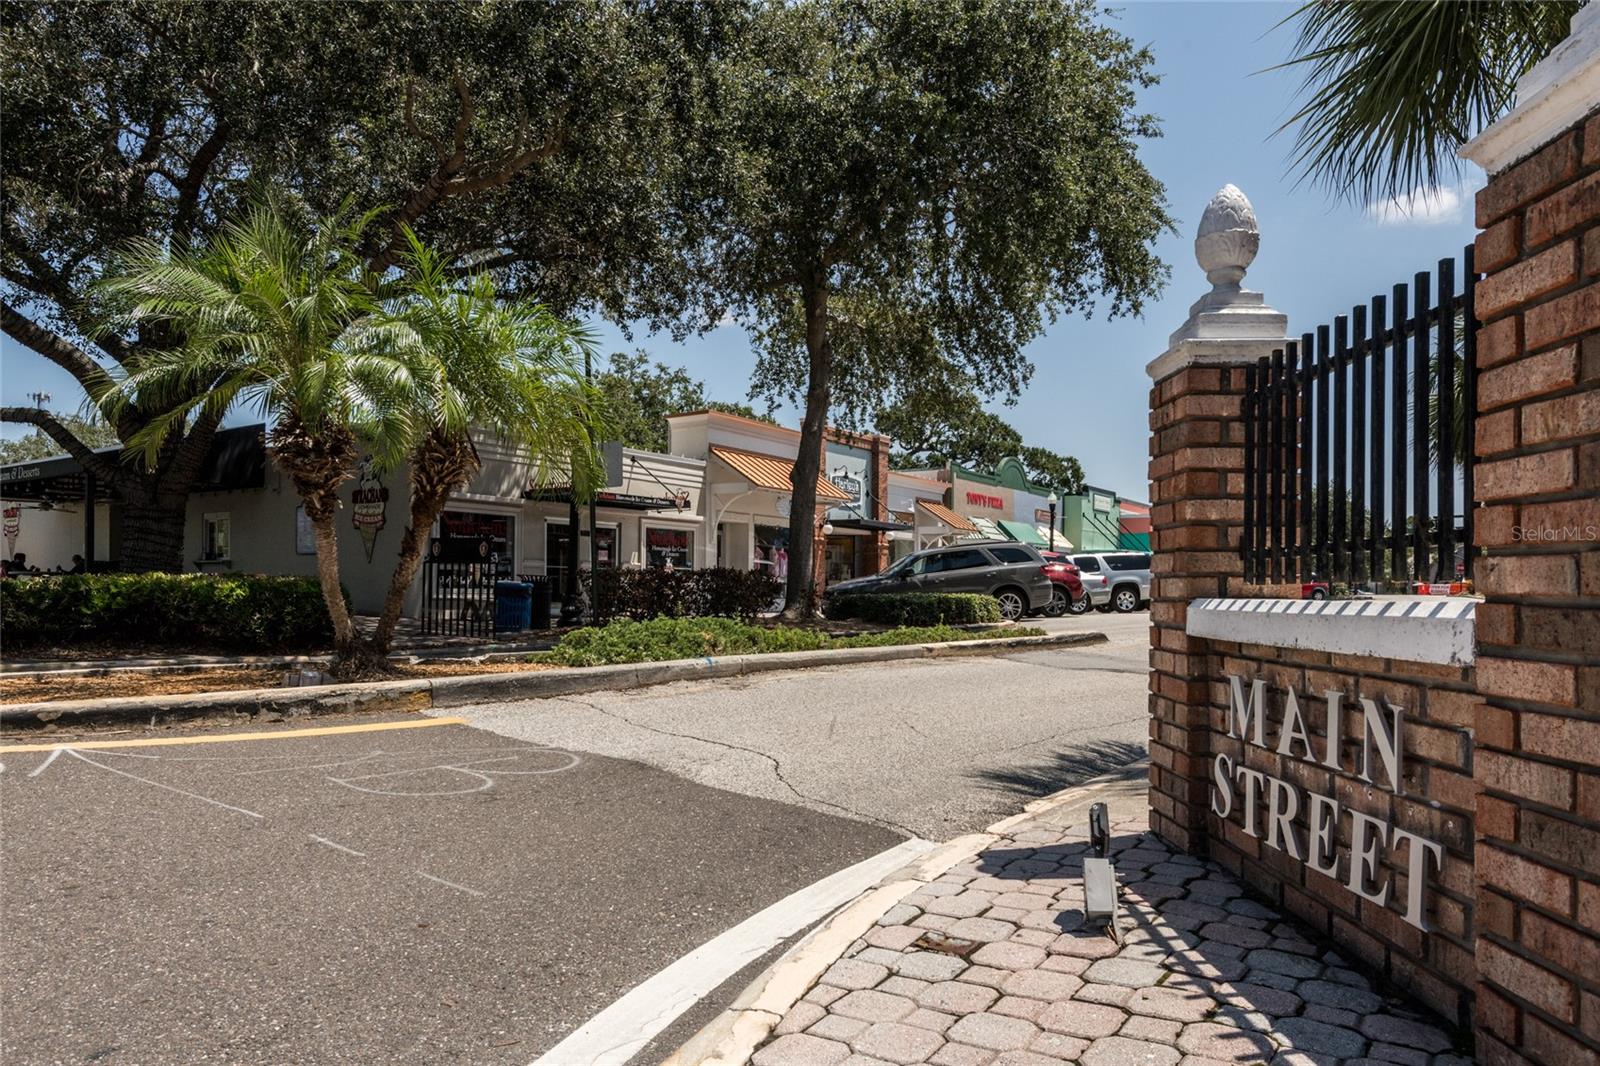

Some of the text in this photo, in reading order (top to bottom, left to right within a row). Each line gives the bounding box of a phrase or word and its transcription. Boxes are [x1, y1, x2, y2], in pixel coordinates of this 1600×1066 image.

[966, 491, 1004, 510] TONY'S PIZZA
[1226, 674, 1405, 796] MAIN
[1211, 752, 1444, 933] STREET
